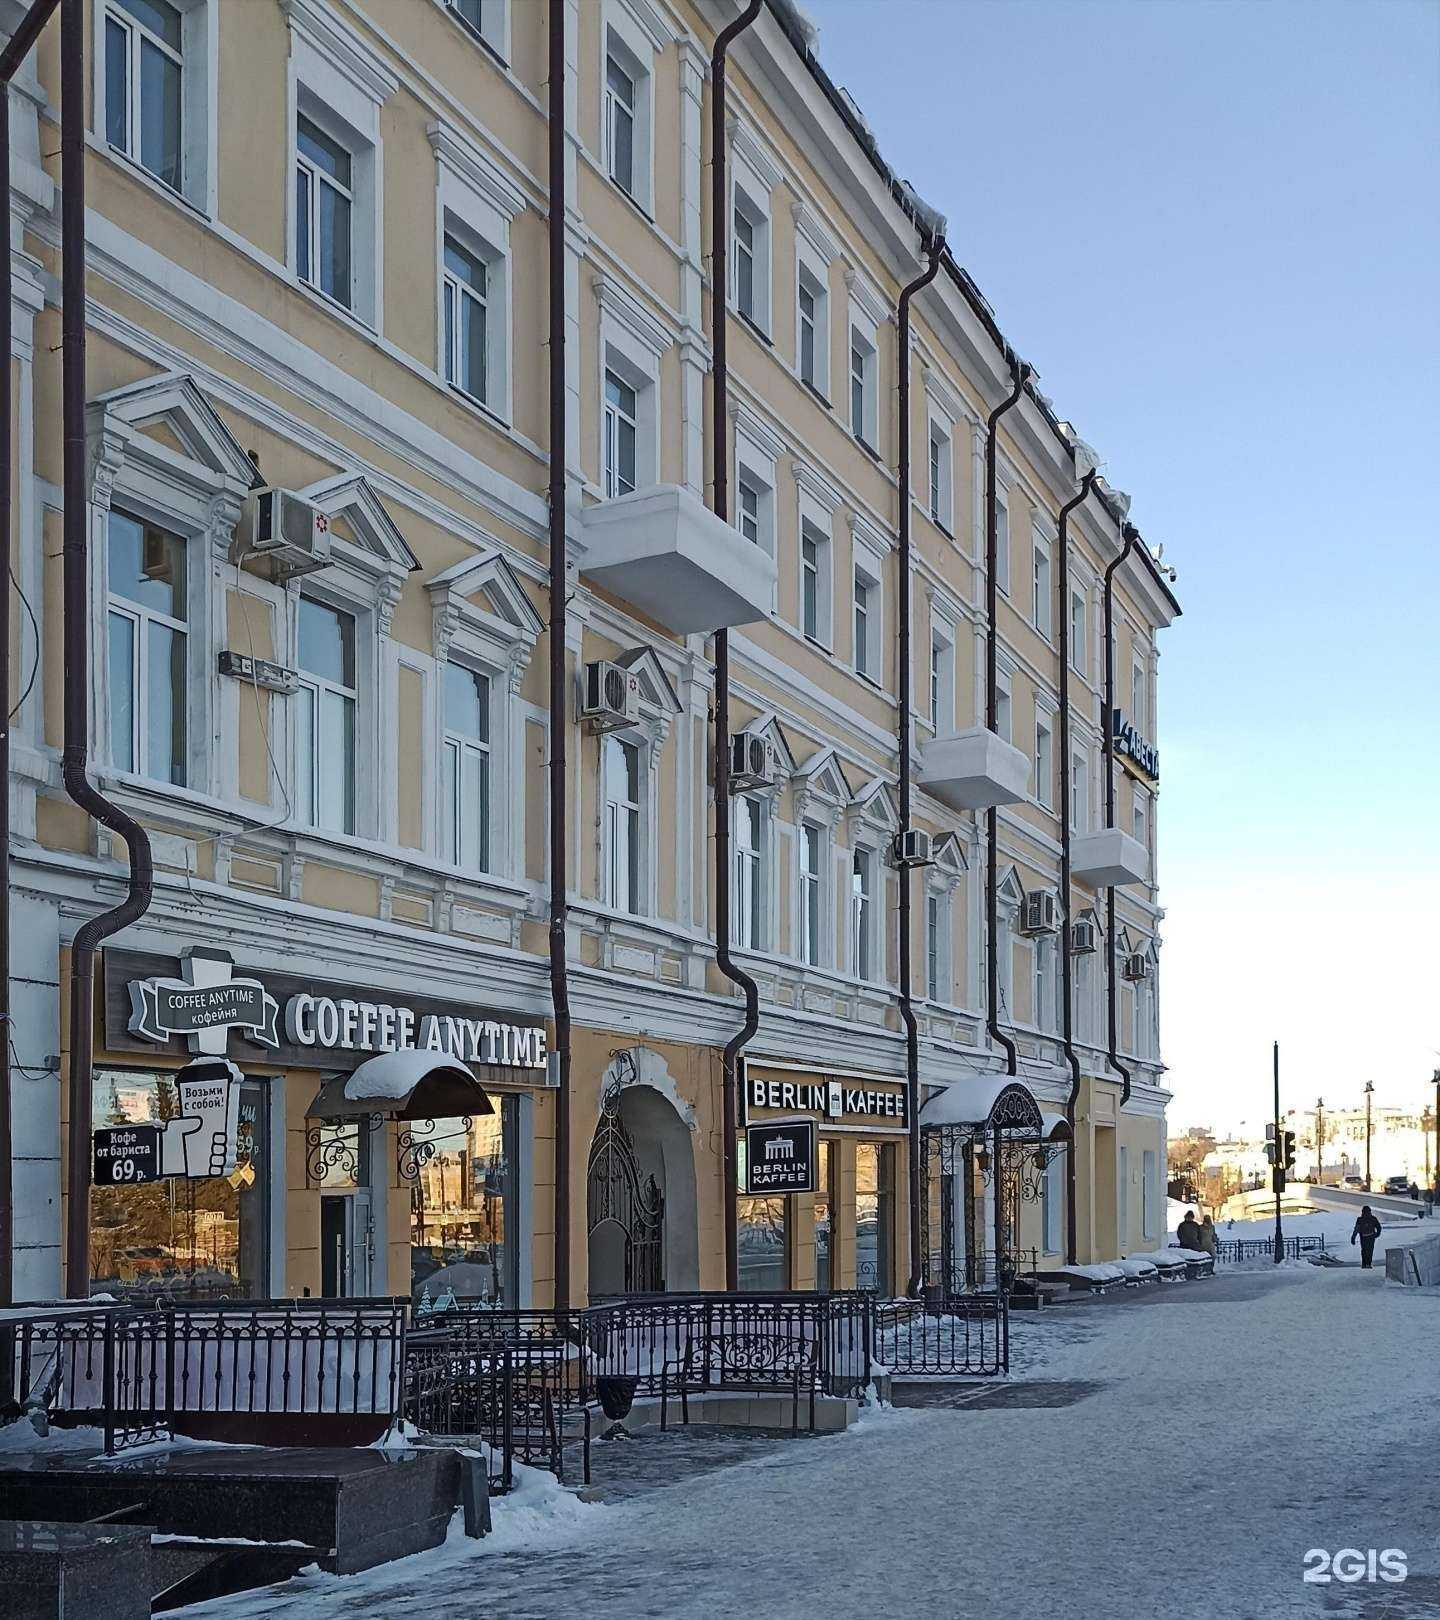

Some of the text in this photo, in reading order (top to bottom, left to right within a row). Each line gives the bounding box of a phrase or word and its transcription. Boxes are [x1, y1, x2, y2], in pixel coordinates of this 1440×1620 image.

[168, 989, 254, 1009] COFFEE ANYTIME
[191, 1008, 237, 1025] кофейня
[293, 994, 547, 1068] COFFEE ANYTIME
[184, 1087, 223, 1098] Возьми
[753, 1080, 904, 1116] BERLIN KAFFEE
[191, 1097, 224, 1109] собой!
[110, 1132, 137, 1144] Кофе
[97, 1143, 151, 1157] от бариста
[112, 1159, 135, 1181] 69
[753, 1162, 807, 1174] BERLIN
[753, 1173, 806, 1184] KAFFEE
